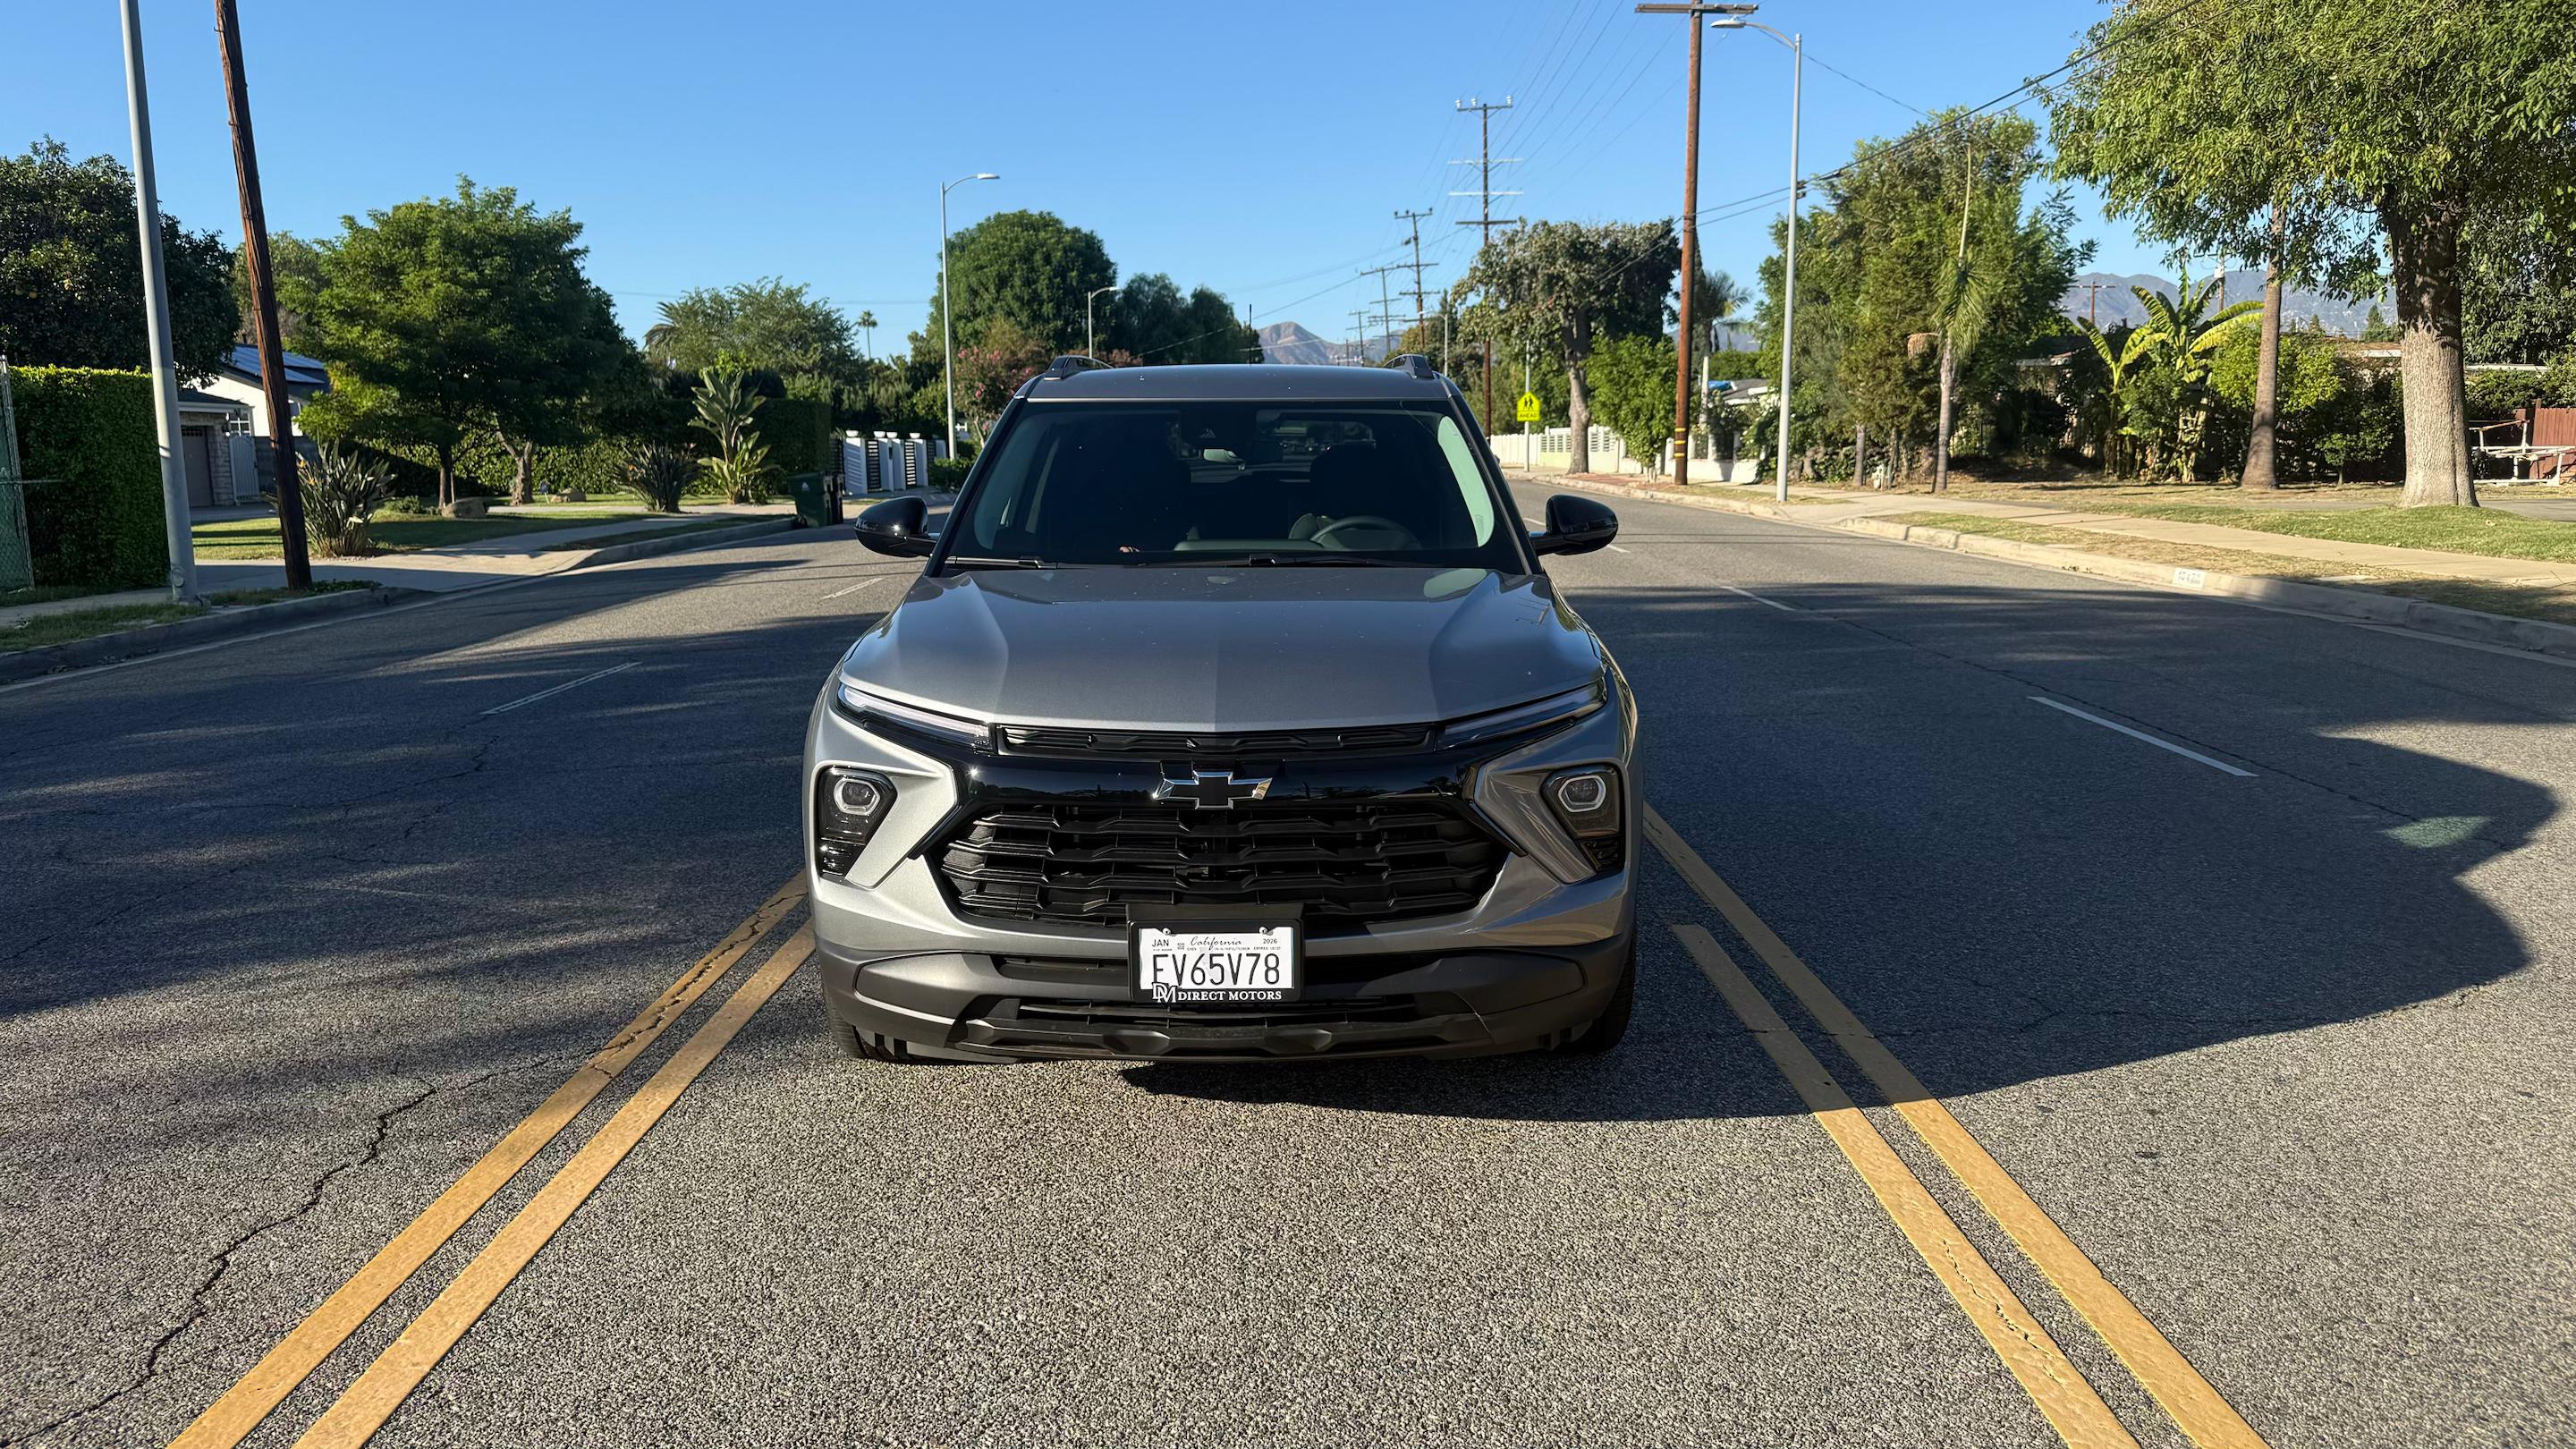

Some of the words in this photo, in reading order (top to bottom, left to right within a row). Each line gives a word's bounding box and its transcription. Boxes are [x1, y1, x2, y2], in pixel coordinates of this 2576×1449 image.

[1152, 939, 1169, 947] JAN
[1191, 936, 1242, 951] California
[1178, 991, 1226, 1001] DIRECT
[1228, 990, 1282, 1001] MOTORS
